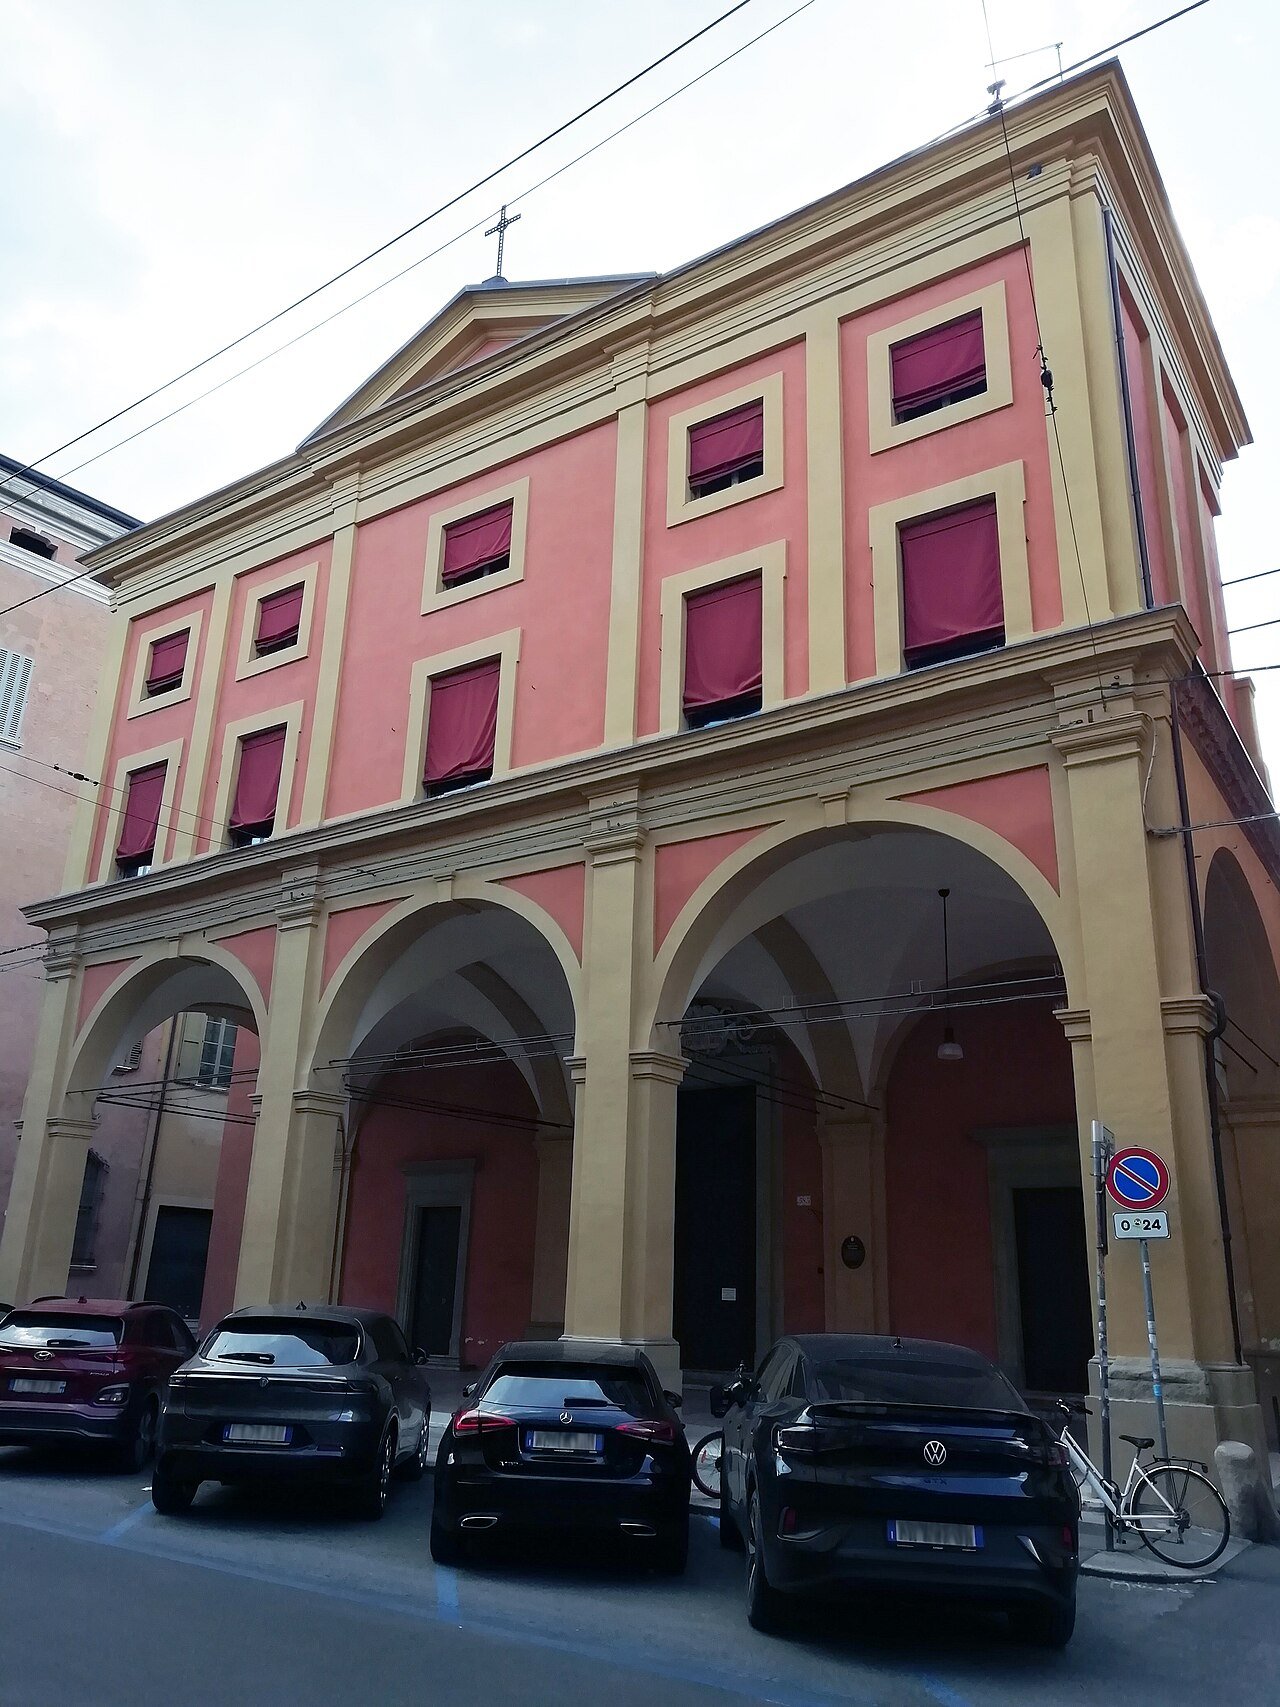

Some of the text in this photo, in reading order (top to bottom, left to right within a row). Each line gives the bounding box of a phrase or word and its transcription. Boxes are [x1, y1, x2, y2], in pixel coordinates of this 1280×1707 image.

[1121, 1219, 1161, 1231] 0 24
[923, 1440, 947, 1466] VW
